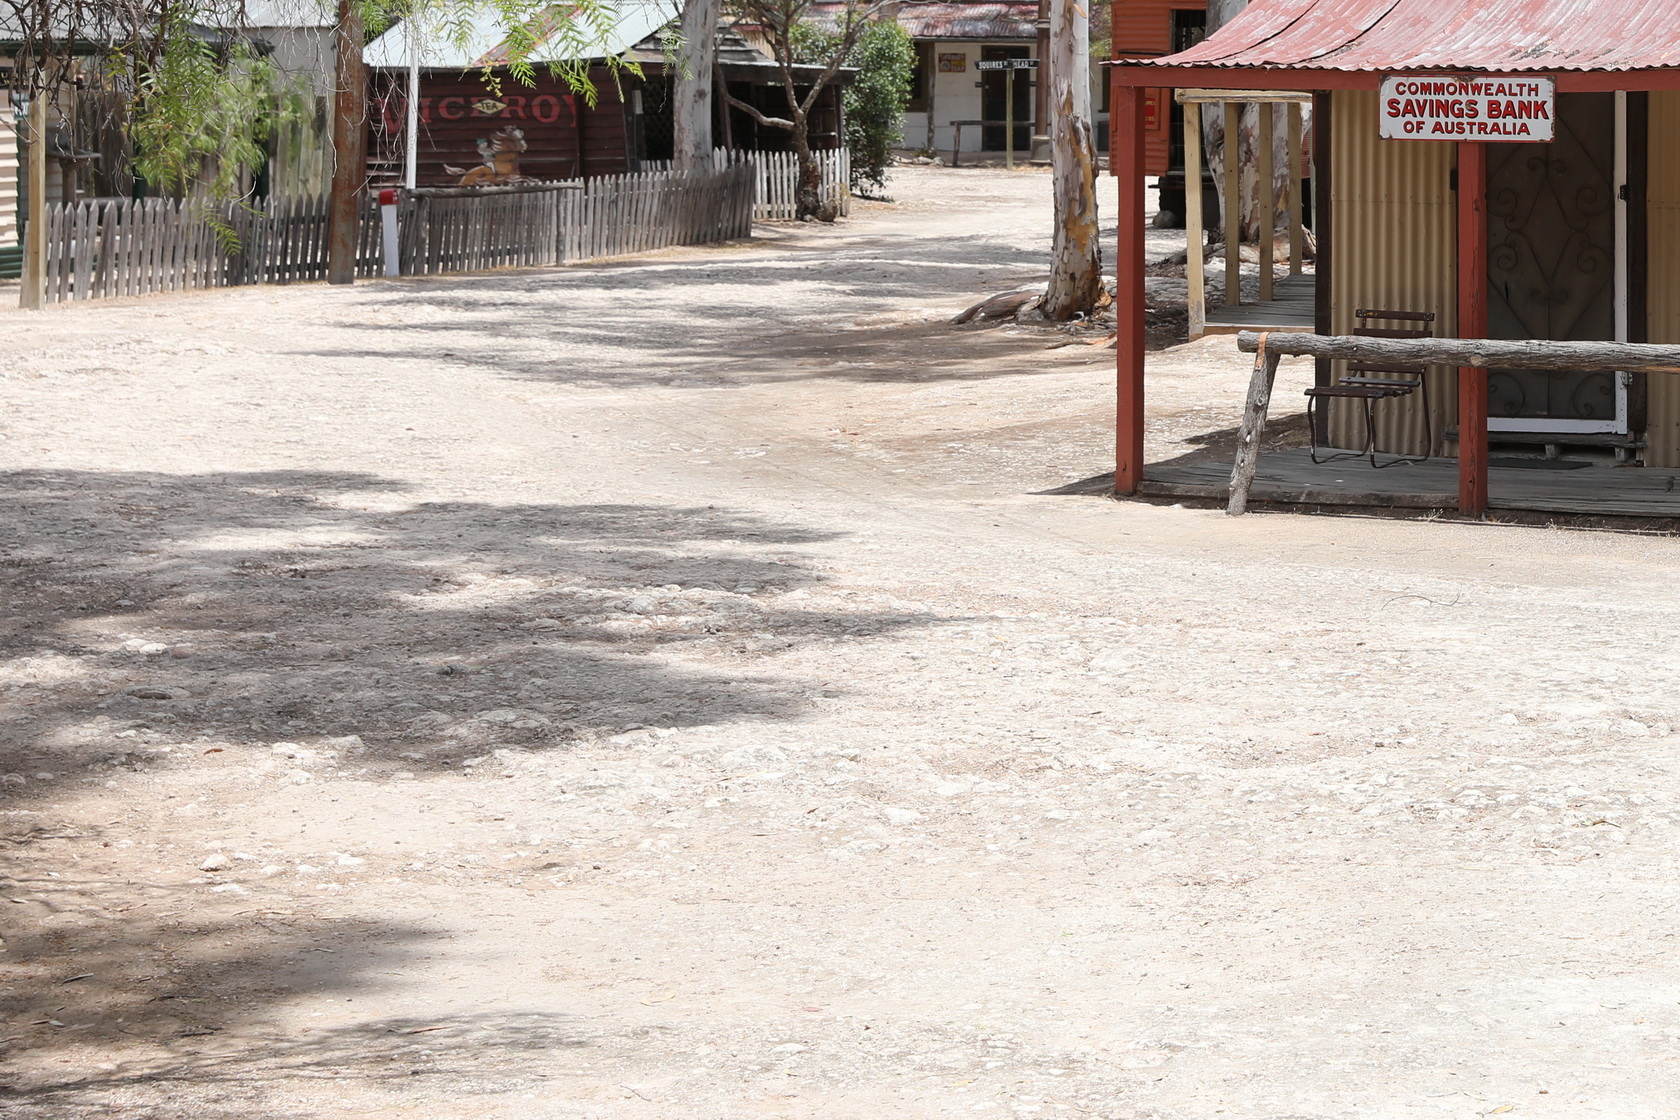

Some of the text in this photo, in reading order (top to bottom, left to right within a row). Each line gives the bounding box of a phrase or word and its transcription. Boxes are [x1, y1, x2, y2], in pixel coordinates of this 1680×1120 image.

[1395, 82, 1539, 96] COMMONWEALTH
[480, 101, 498, 111] TEA
[1387, 98, 1549, 120] SAVINGS BANK
[1403, 121, 1531, 135] OF AUSTRALIA
